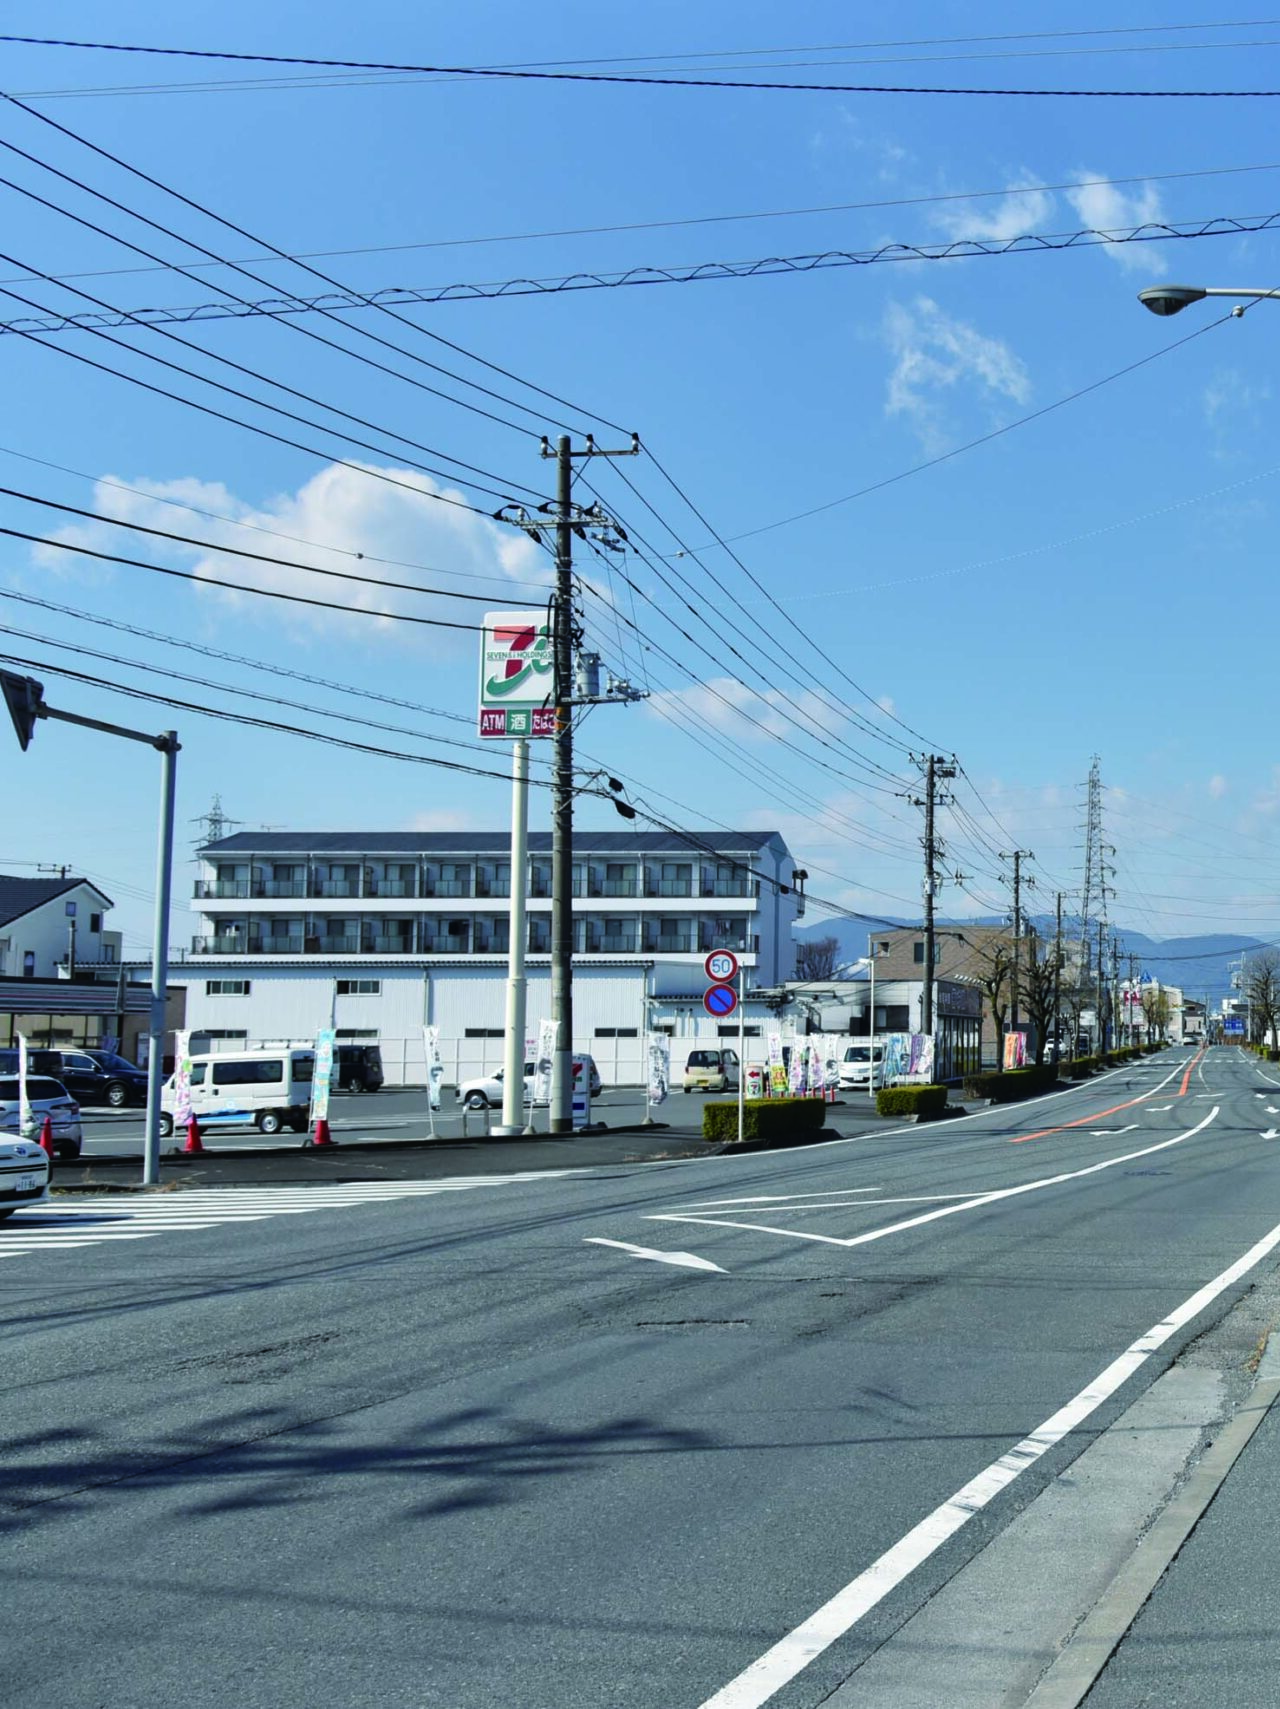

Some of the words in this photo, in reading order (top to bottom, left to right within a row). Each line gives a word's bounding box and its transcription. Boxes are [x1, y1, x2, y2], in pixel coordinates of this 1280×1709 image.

[517, 651, 553, 659] HOLDINGS
[482, 714, 505, 731] ATM
[511, 714, 527, 730] 酒
[533, 713, 557, 730] たばこ
[712, 958, 731, 974] 50
